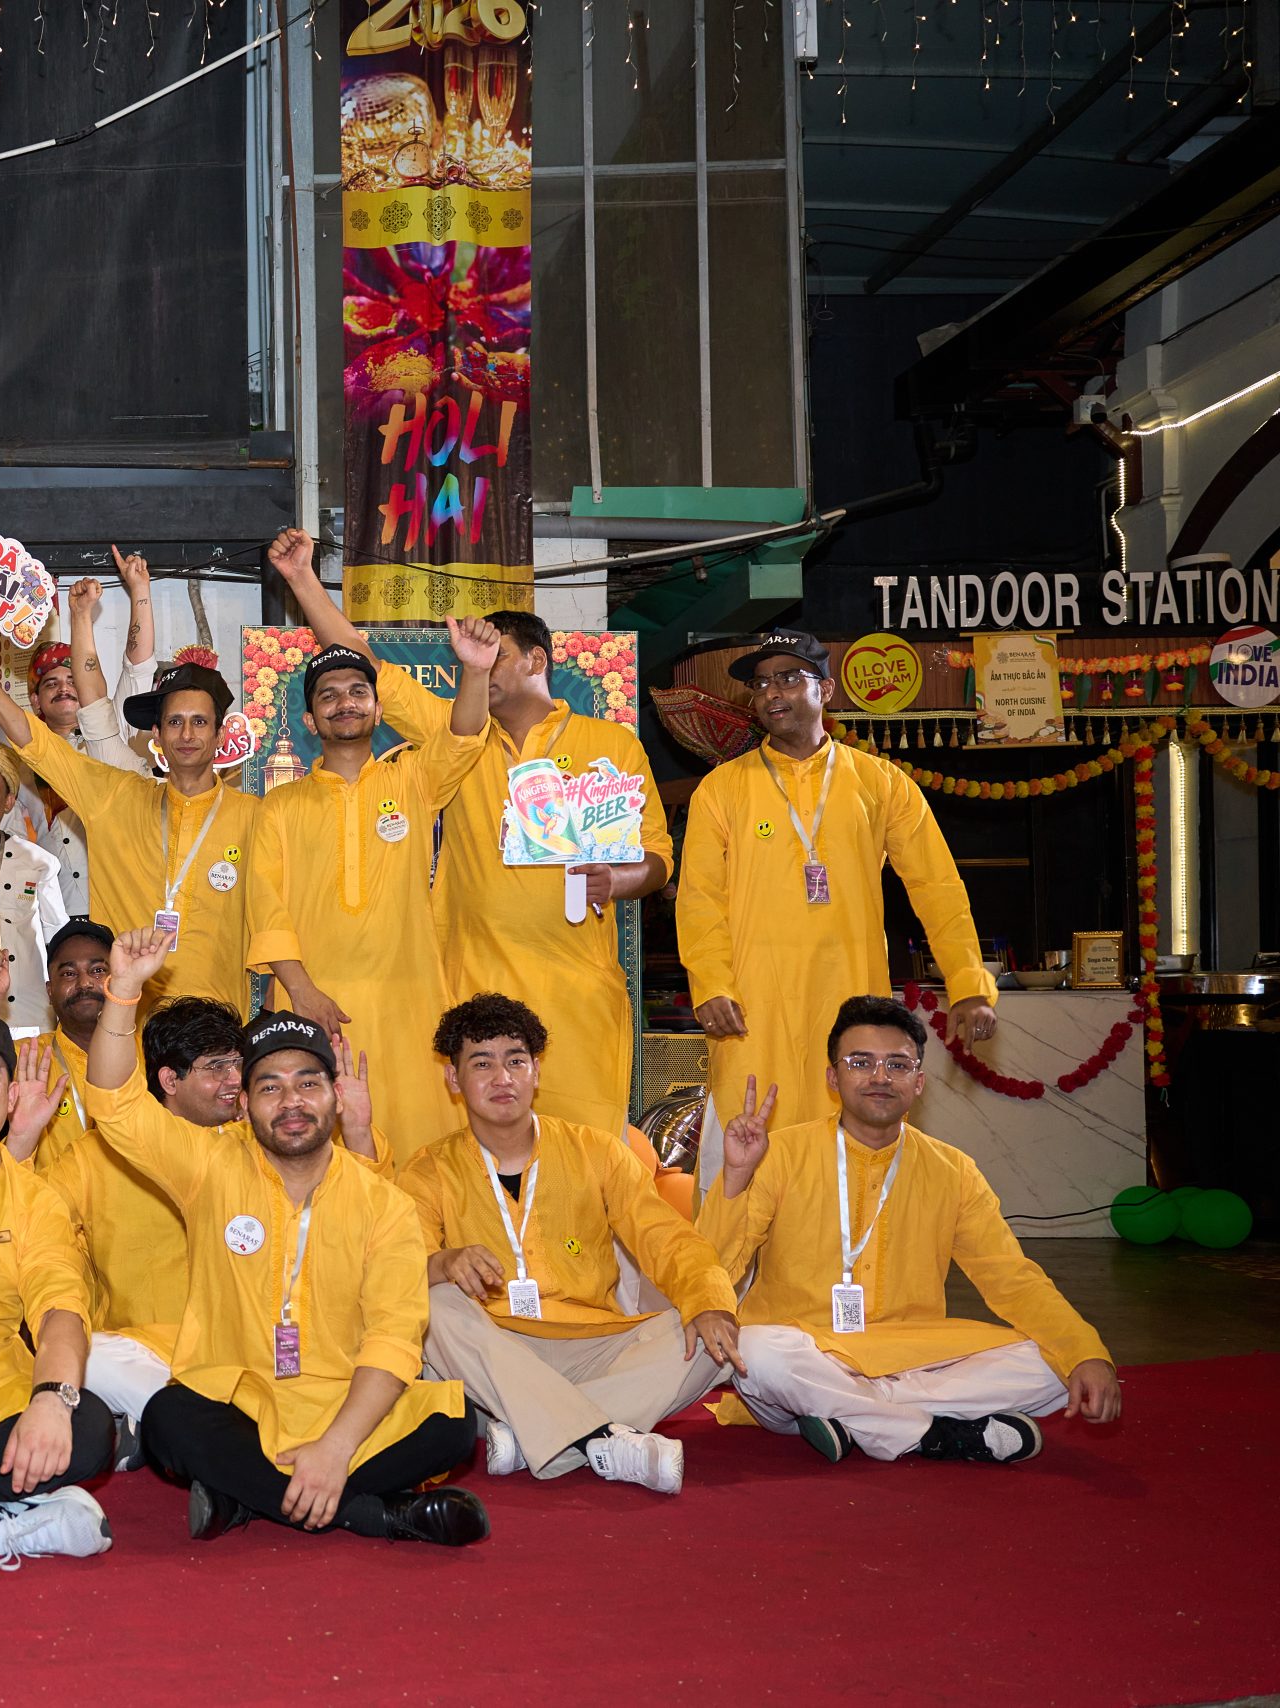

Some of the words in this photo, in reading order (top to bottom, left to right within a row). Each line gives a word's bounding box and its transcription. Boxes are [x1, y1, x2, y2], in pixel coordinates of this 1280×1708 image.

[378, 392, 518, 471] HOLI
[378, 472, 491, 552] HAI
[873, 571, 1082, 629] TANDOOR
[1102, 568, 1280, 627] STATION
[853, 666, 858, 678] I
[862, 659, 907, 677] LOVE
[854, 673, 912, 690] VIETNAM
[1217, 662, 1279, 688] INDIA
[995, 698, 1019, 706] NORTH
[1019, 696, 1047, 705] CUISINE
[1017, 708, 1036, 716] INDIA
[565, 774, 643, 809] #Kingfisher
[580, 795, 628, 832] BEER
[595, 1454, 606, 1471] NIKE
